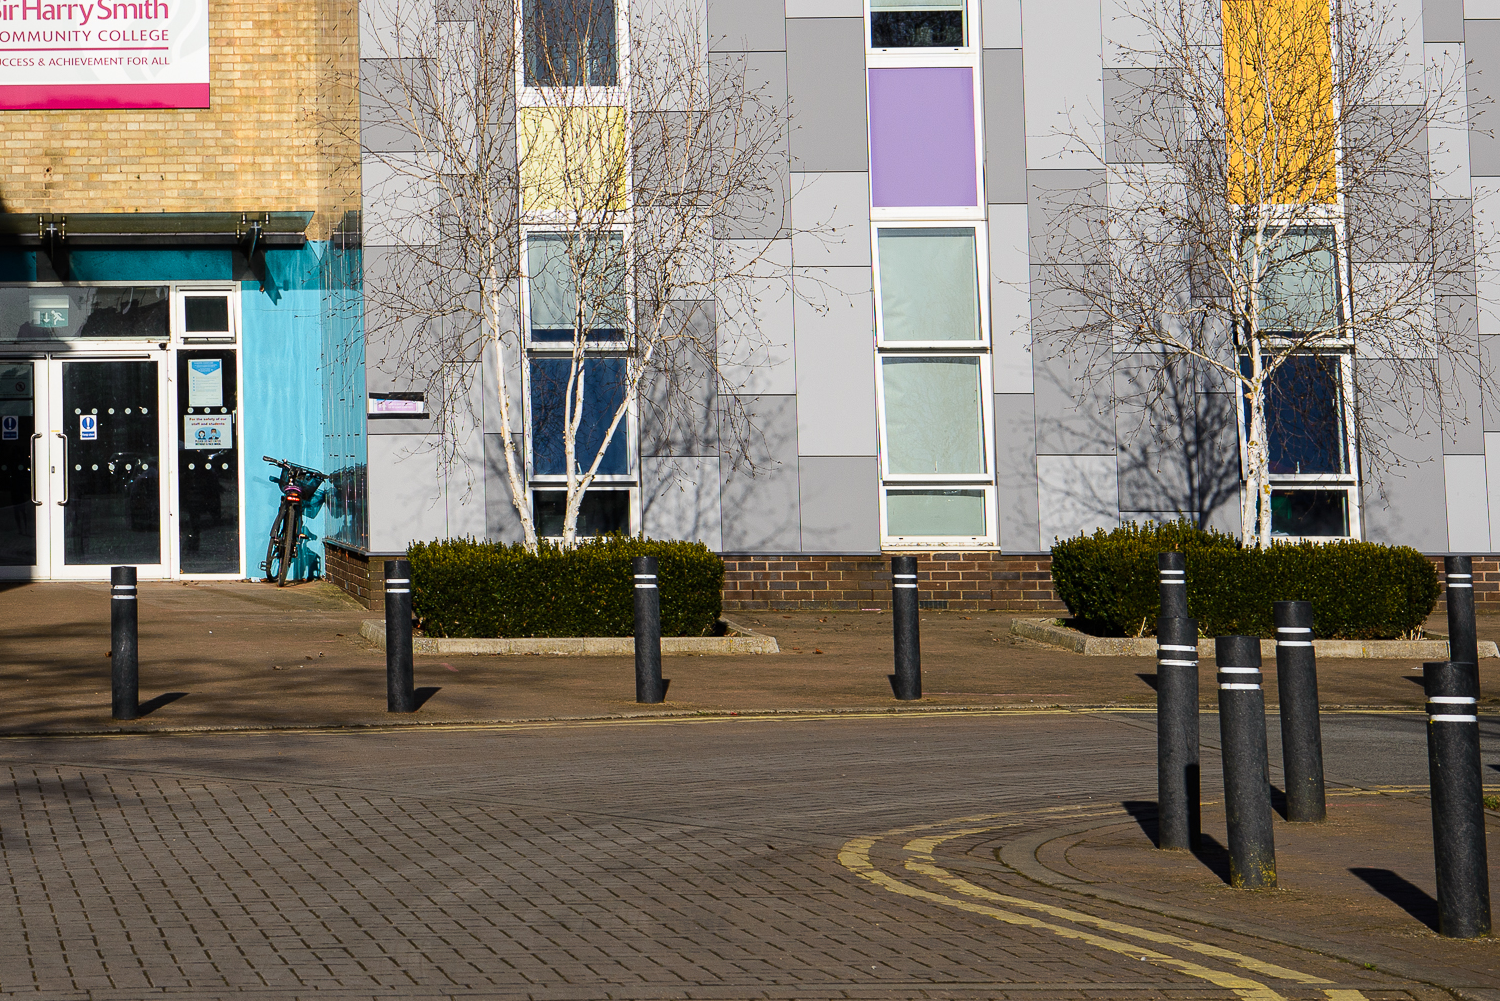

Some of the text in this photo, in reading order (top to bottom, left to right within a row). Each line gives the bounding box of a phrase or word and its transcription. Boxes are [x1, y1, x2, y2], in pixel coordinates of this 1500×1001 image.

[98, 29, 169, 42] COLLEGE
[37, 57, 46, 67] &
[48, 56, 124, 66] ACHIEVEMENT
[127, 56, 148, 66] FOR
[151, 56, 171, 65] ALL
